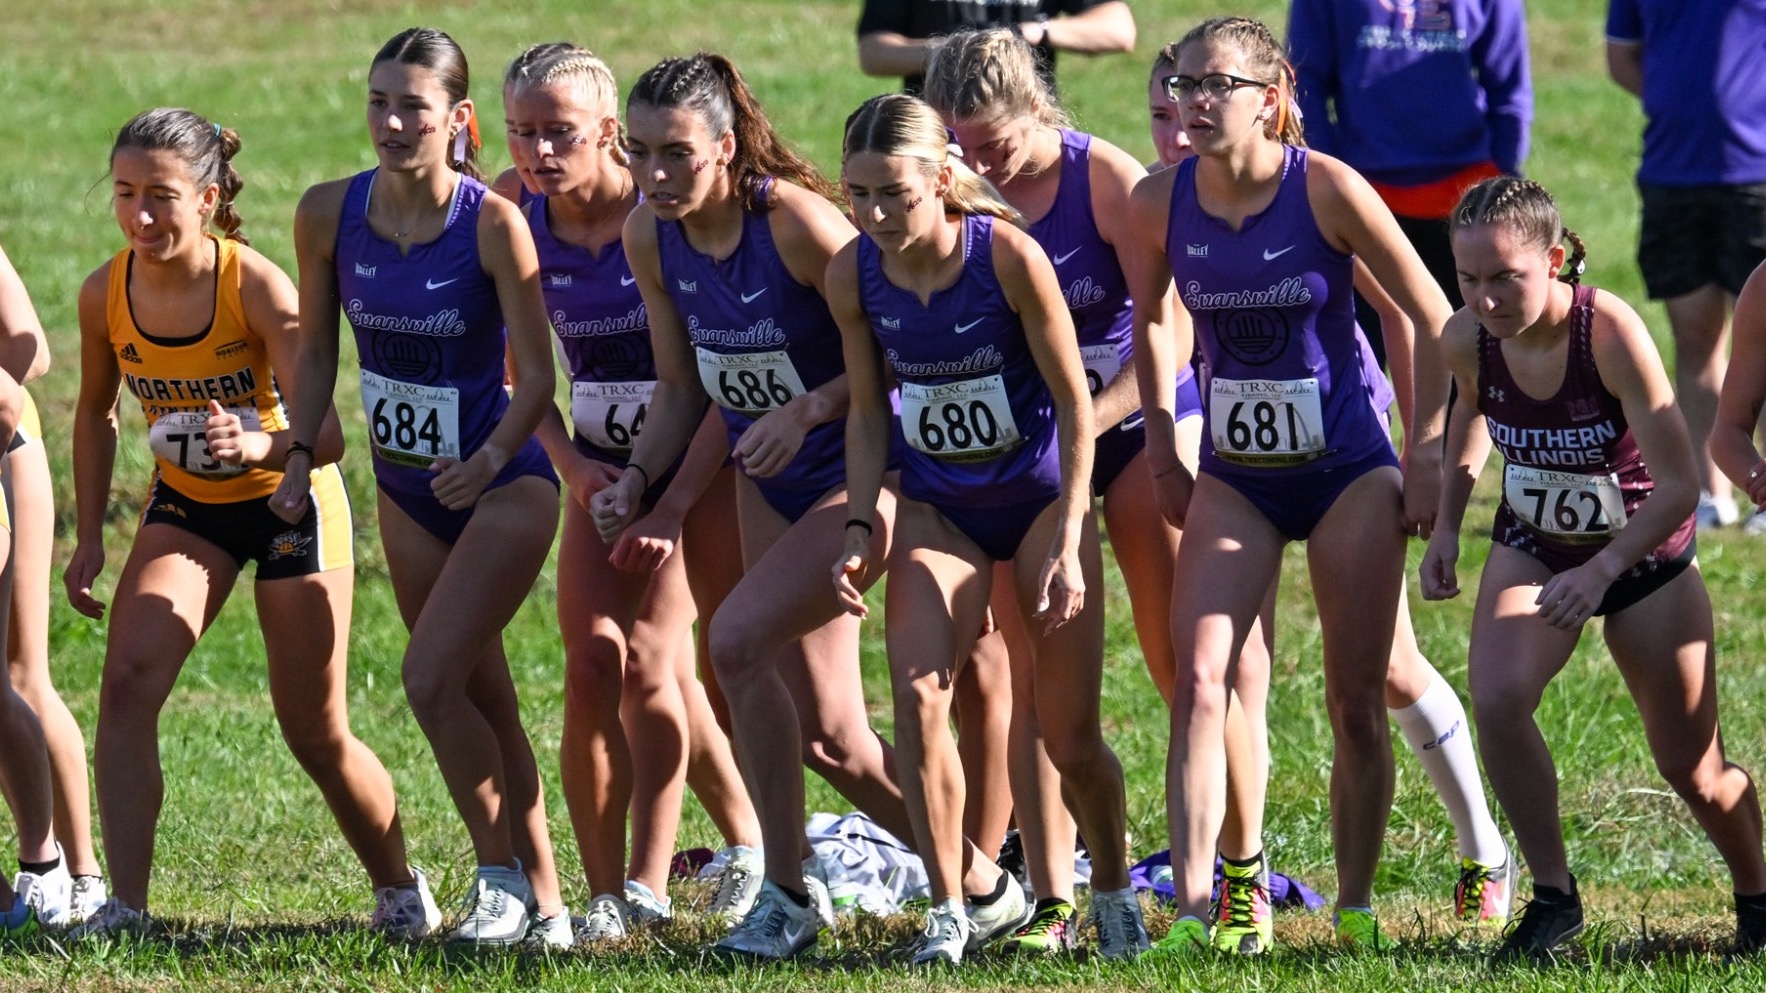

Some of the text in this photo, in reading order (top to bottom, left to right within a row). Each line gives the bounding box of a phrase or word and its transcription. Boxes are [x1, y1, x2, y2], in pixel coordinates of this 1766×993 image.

[1186, 244, 1209, 256] VALLEY
[355, 262, 377, 277] VALLEY
[551, 274, 572, 285] VALLEY
[1184, 276, 1311, 310] Evansville
[347, 298, 466, 337] Evansville
[554, 302, 650, 337] Evansvil
[688, 315, 786, 347] Evansville
[715, 355, 757, 364] TRXC
[887, 344, 1003, 375] Evansville
[125, 367, 257, 401] NORTHERN
[381, 380, 425, 396] TRXC
[597, 384, 645, 395] TRXC
[718, 369, 792, 408] 686
[921, 383, 968, 398] TRXC
[1236, 382, 1284, 393] TRXC
[178, 414, 210, 424] TRX
[372, 397, 441, 455] 684
[918, 400, 997, 451] 680
[1226, 401, 1298, 451] 681
[1487, 416, 1617, 449] SOUTHERN
[166, 432, 249, 470] 73
[1497, 444, 1605, 466] ILLINOIS
[1535, 471, 1583, 483] TRXC
[1523, 488, 1609, 531] 762
